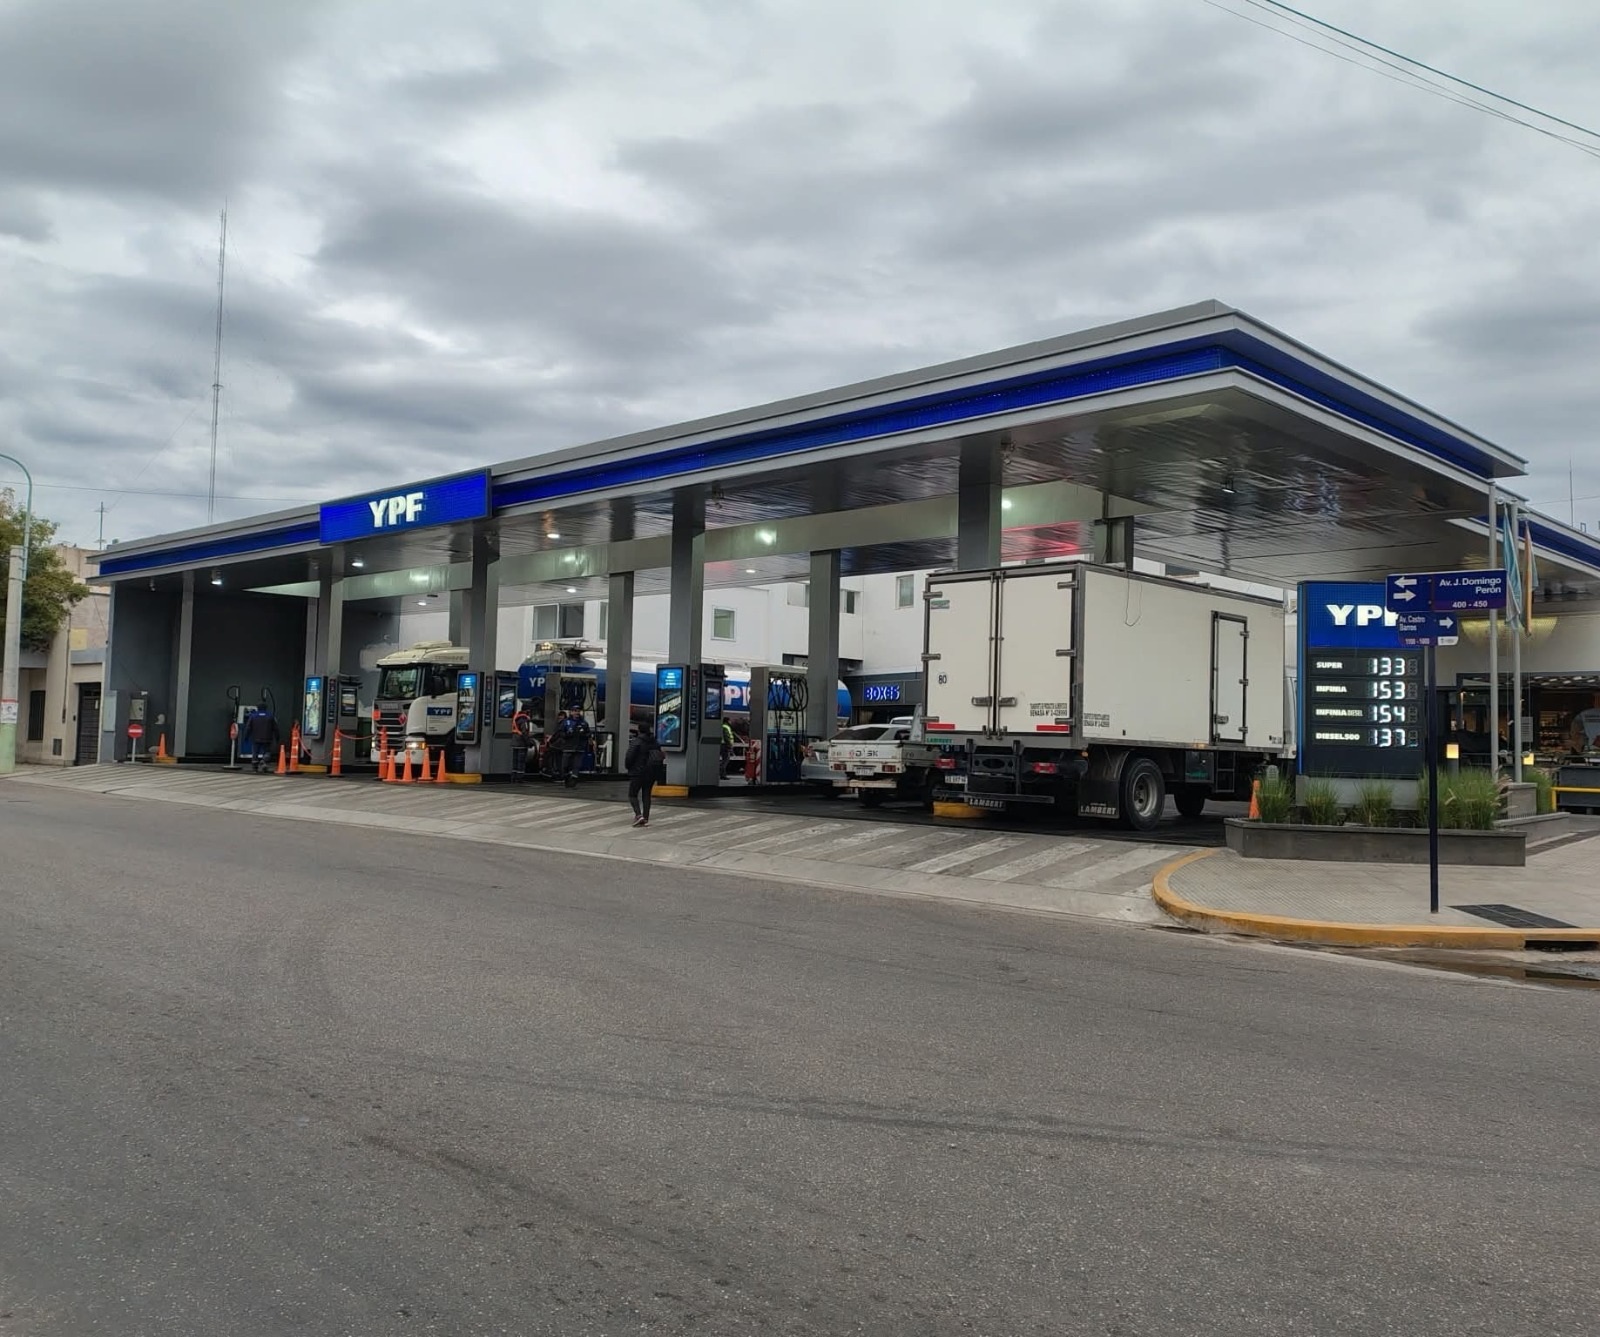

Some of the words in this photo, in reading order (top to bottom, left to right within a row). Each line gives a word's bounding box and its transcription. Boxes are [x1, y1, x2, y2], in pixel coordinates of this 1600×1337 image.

[369, 492, 424, 528] YPF
[1439, 579, 1453, 587] Av.
[1453, 579, 1462, 587] J.
[1462, 576, 1502, 588] Domingo
[1475, 585, 1502, 595] Perón
[1452, 600, 1466, 609] 400
[1473, 600, 1489, 608] 450
[1316, 661, 1343, 669] SUPER
[1373, 657, 1406, 676] 133
[1315, 685, 1347, 693] INFINIA
[1373, 681, 1406, 700] 153
[434, 707, 451, 716] YPF
[1373, 704, 1406, 724] 154
[1373, 728, 1406, 748] 137
[969, 798, 1004, 809] LAMBERT
[1080, 805, 1117, 816] LAMBERT
